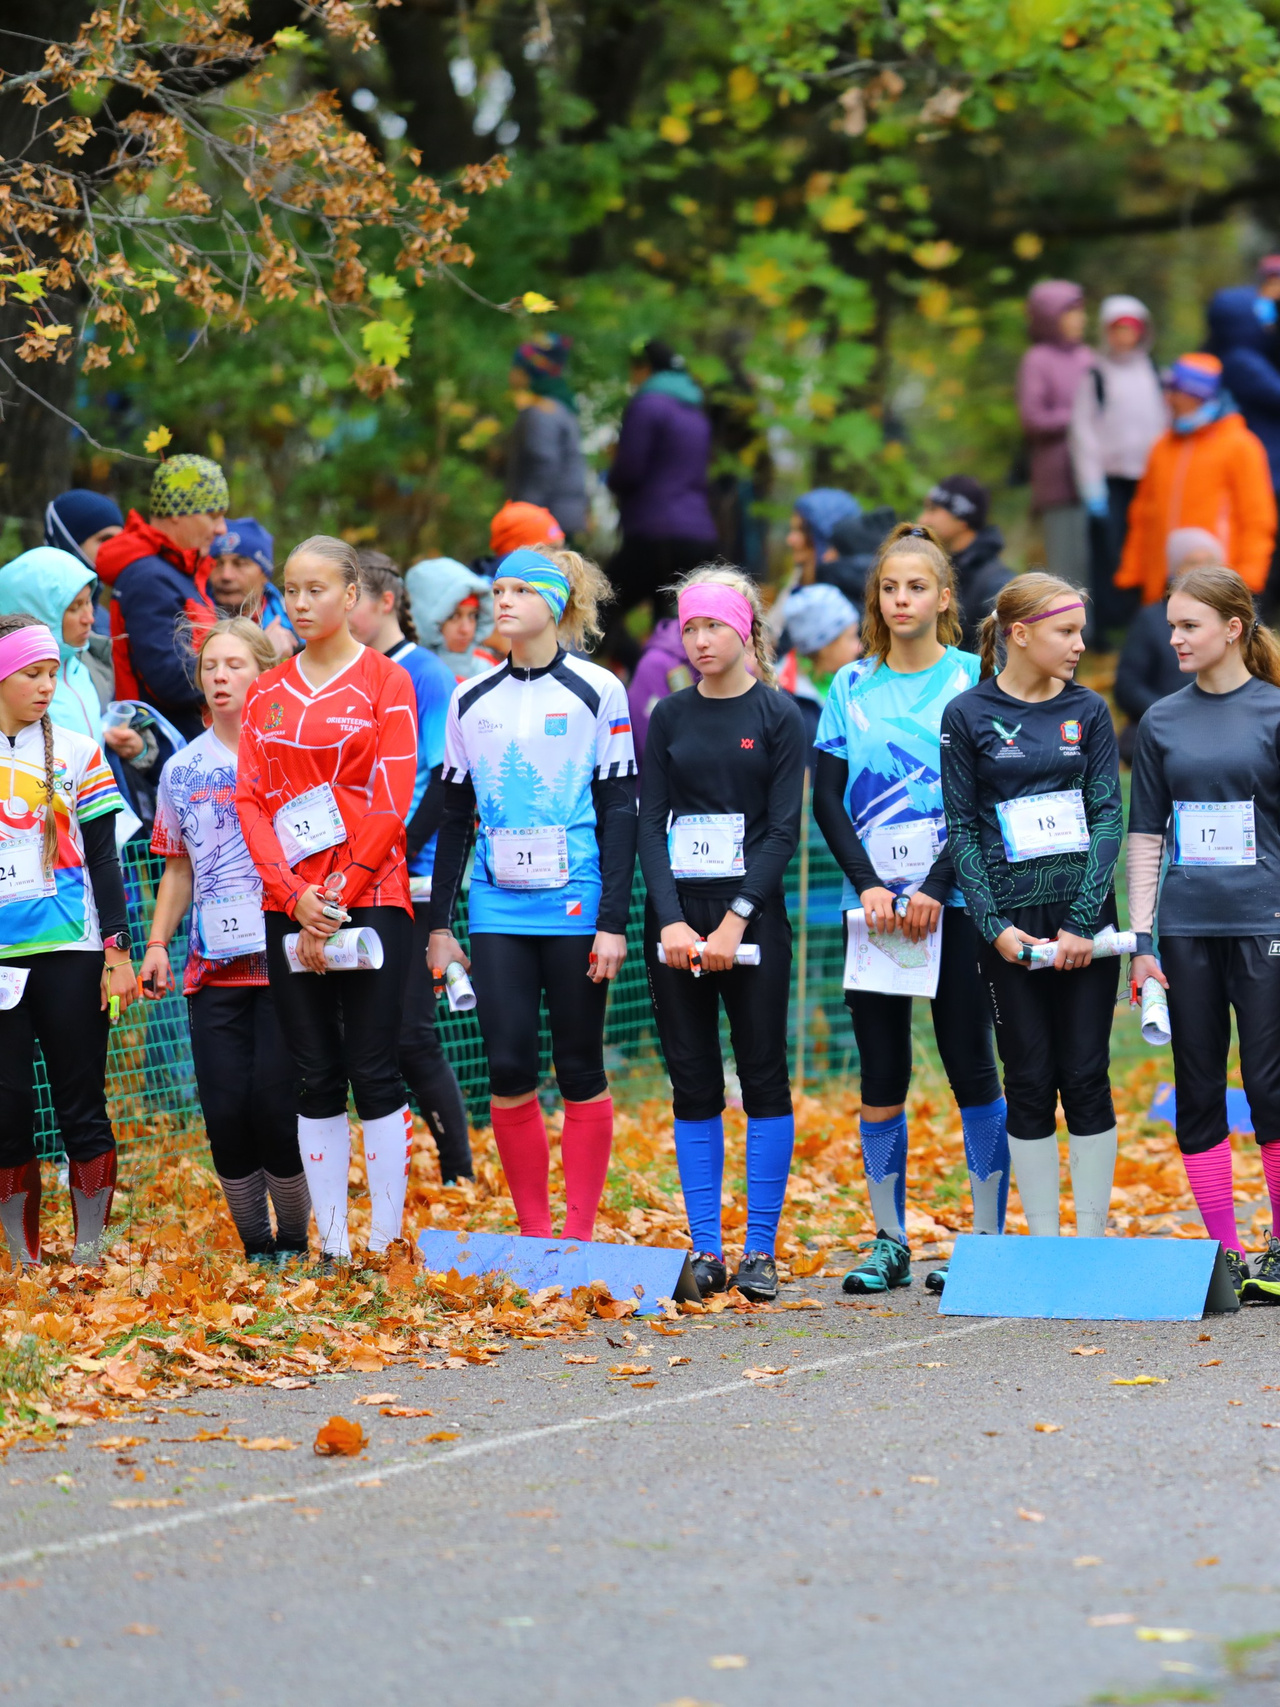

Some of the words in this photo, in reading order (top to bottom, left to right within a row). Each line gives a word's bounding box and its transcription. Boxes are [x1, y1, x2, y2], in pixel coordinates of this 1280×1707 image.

[294, 820, 311, 838] 23
[1037, 815, 1056, 831] 18
[1201, 828, 1216, 843] 17
[692, 841, 710, 856] 20
[891, 845, 909, 860] 19
[516, 851, 533, 866] 21
[0, 864, 17, 881] 24
[222, 918, 239, 933] 22
